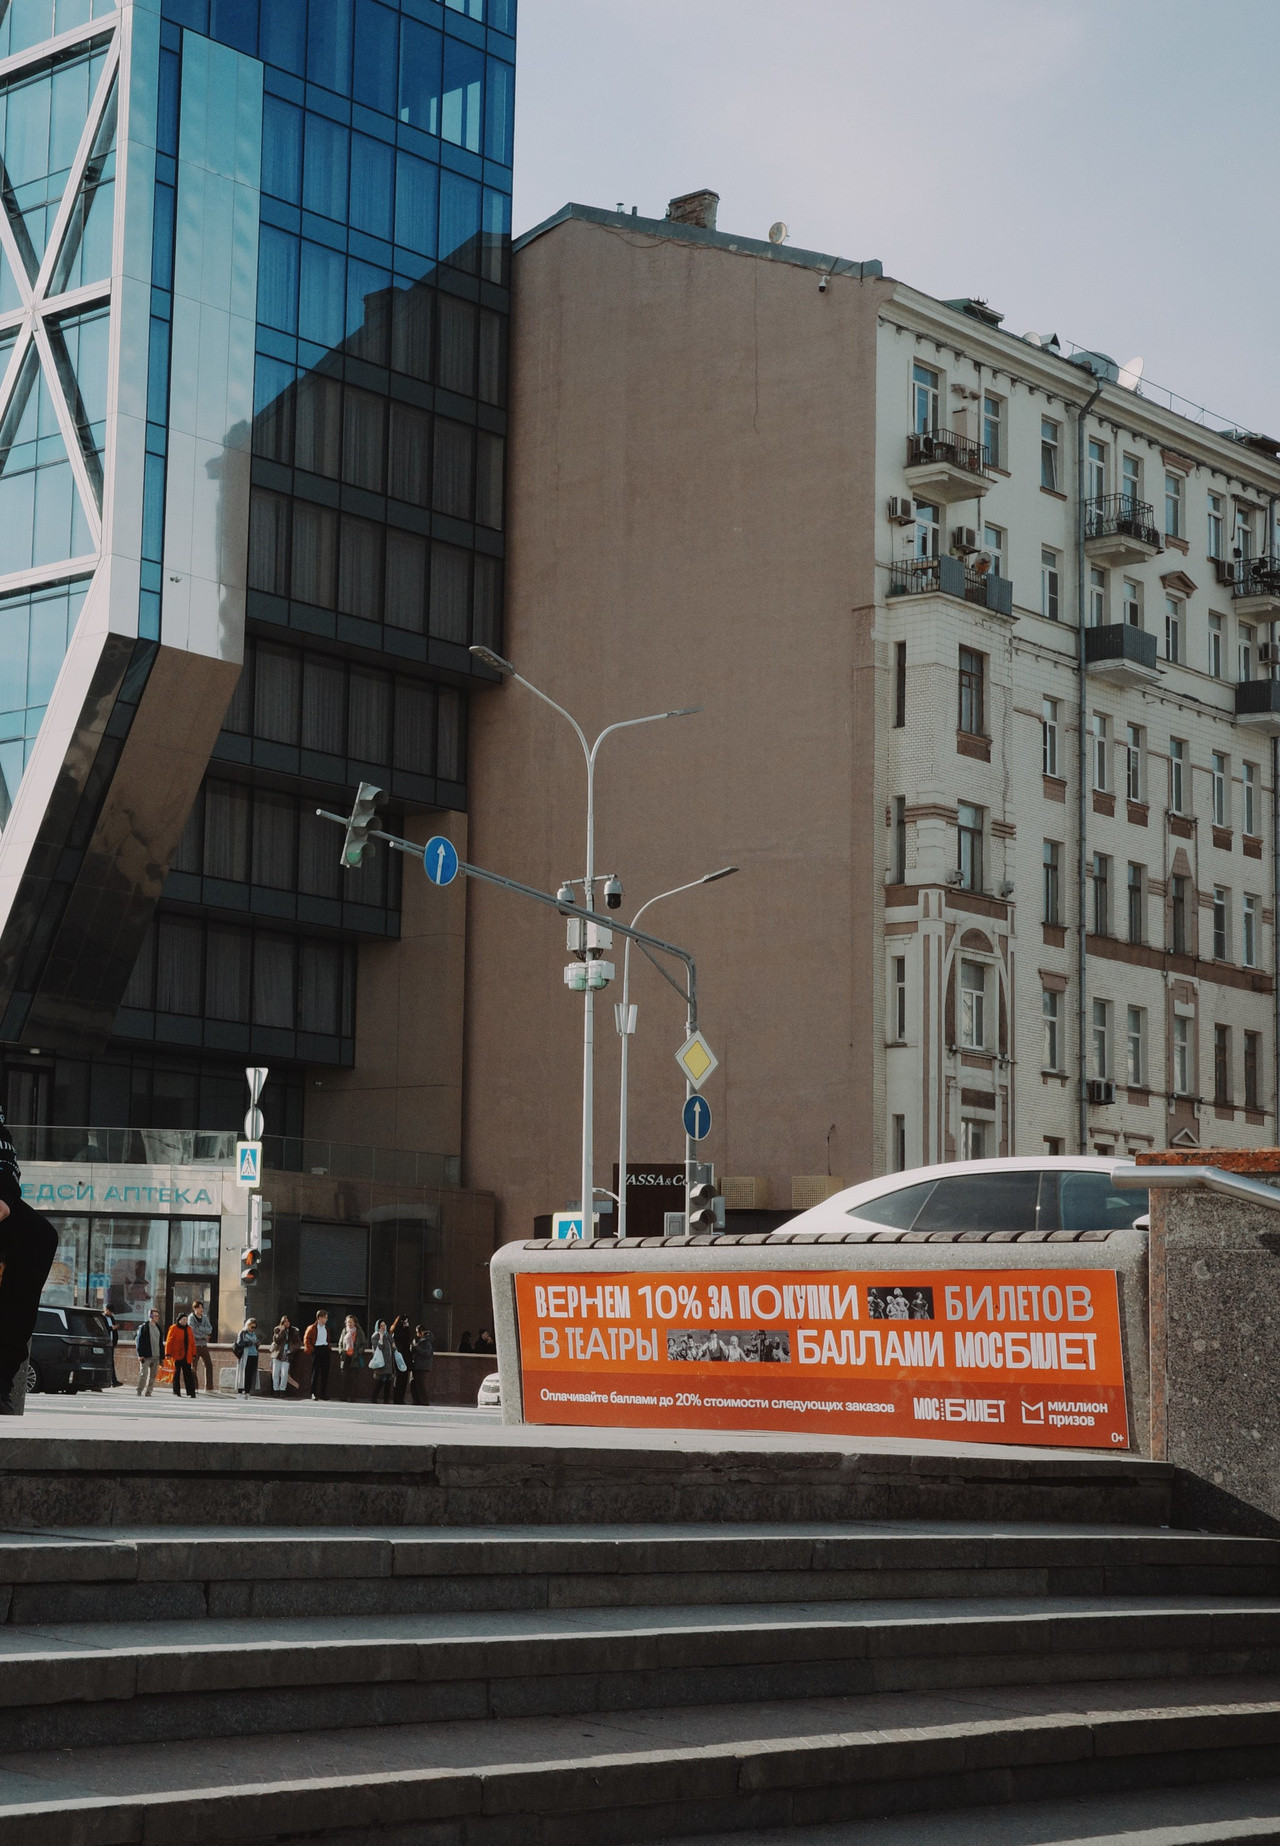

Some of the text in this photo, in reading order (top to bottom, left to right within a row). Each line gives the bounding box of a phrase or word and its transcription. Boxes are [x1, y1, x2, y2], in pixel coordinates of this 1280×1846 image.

[20, 1183, 212, 1205] ЕДСИ АПТЕКА
[534, 1284, 1094, 1322] ВЕРНЕМ 10% ЗА ПОКУПКИ БИЛЕТОВ
[539, 1326, 1098, 1371] В ТЕАТРЫ БАЛЛАМИ МОСБИЛЕТ
[540, 1388, 895, 1414] Оплачивайте баллами до 20% стоимости следующих заказов
[1048, 1414, 1096, 1427] призов
[1111, 1432, 1125, 1443] 0+
